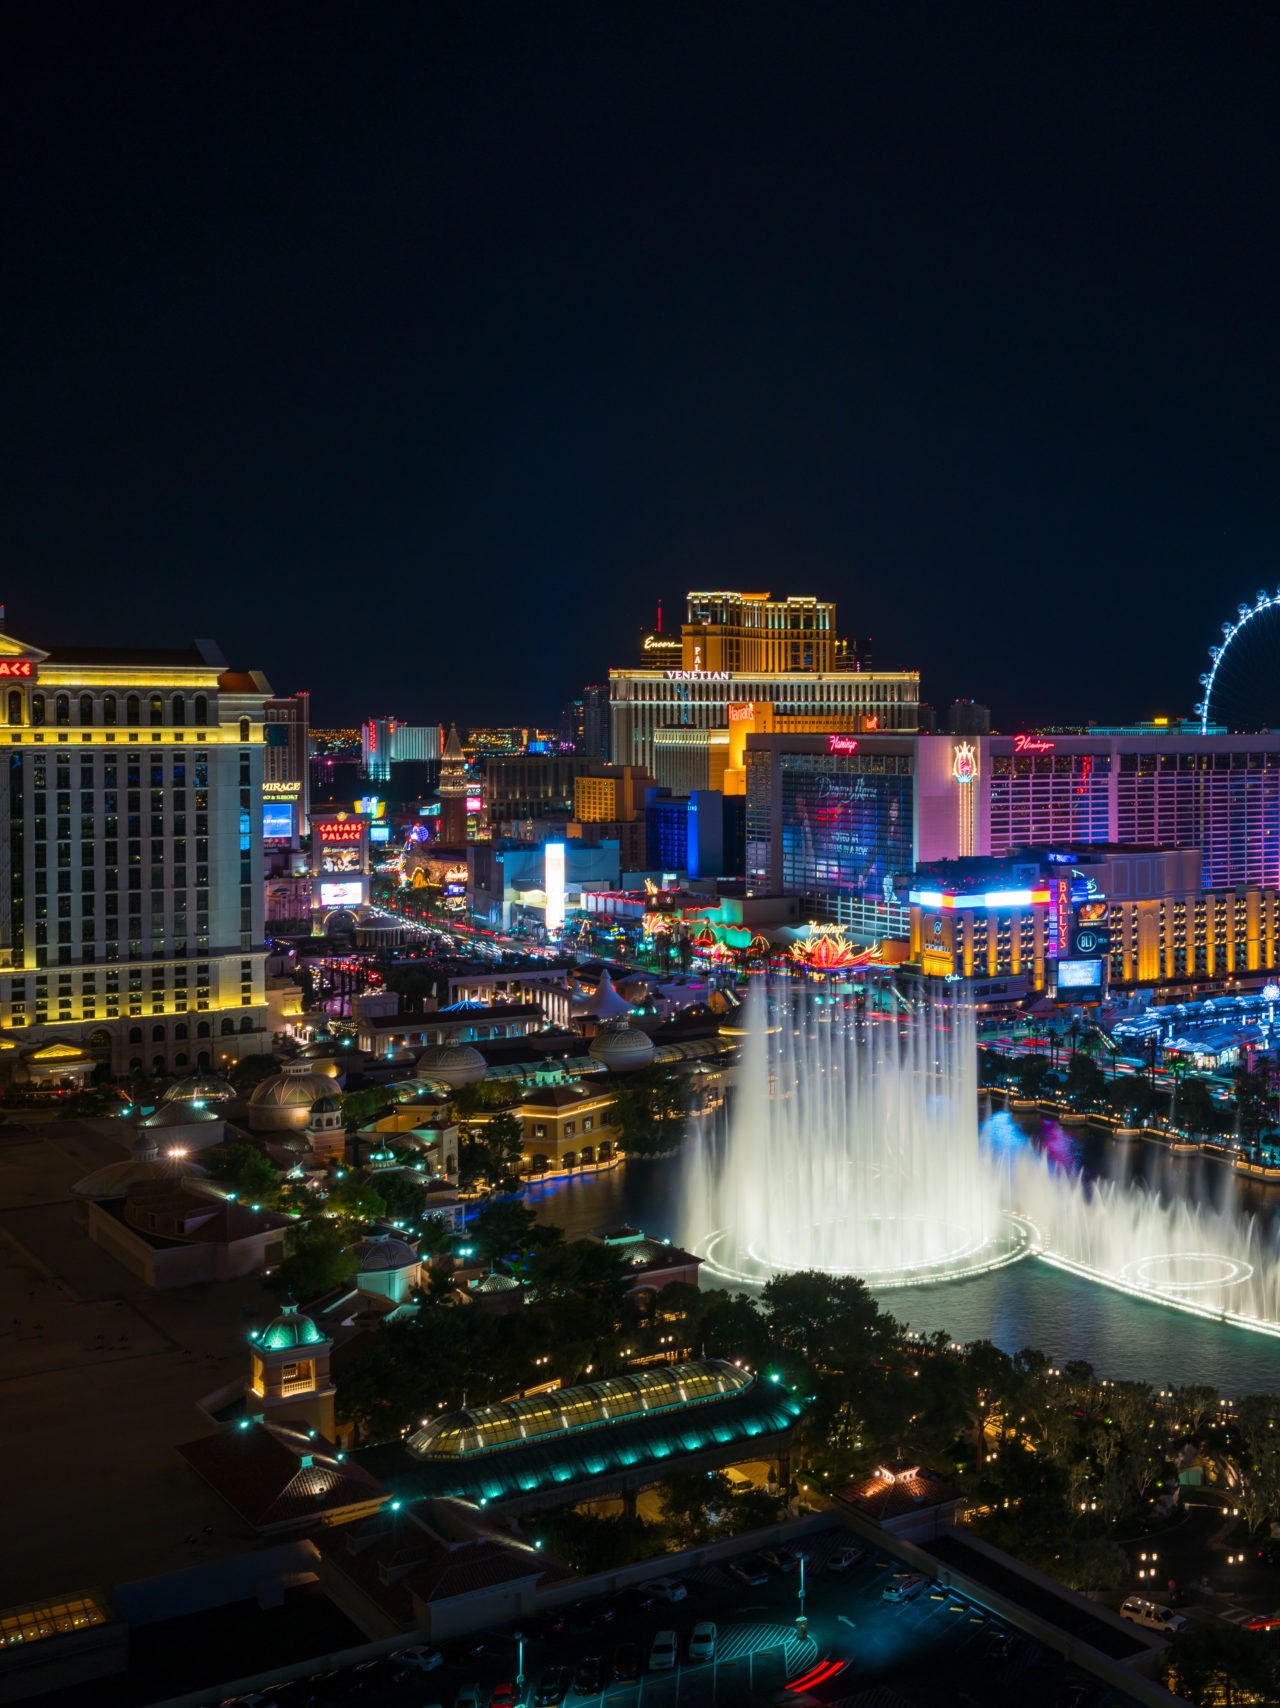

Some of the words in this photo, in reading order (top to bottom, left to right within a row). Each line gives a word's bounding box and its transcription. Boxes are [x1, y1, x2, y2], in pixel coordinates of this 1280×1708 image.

[644, 636, 683, 649] Encore
[667, 671, 729, 680] VENETIAN
[829, 735, 857, 754] Flamingo
[1013, 735, 1055, 753] Flamingo
[320, 824, 362, 832] CAESARS
[322, 832, 360, 840] PALACE
[1081, 936, 1092, 948] BLT
